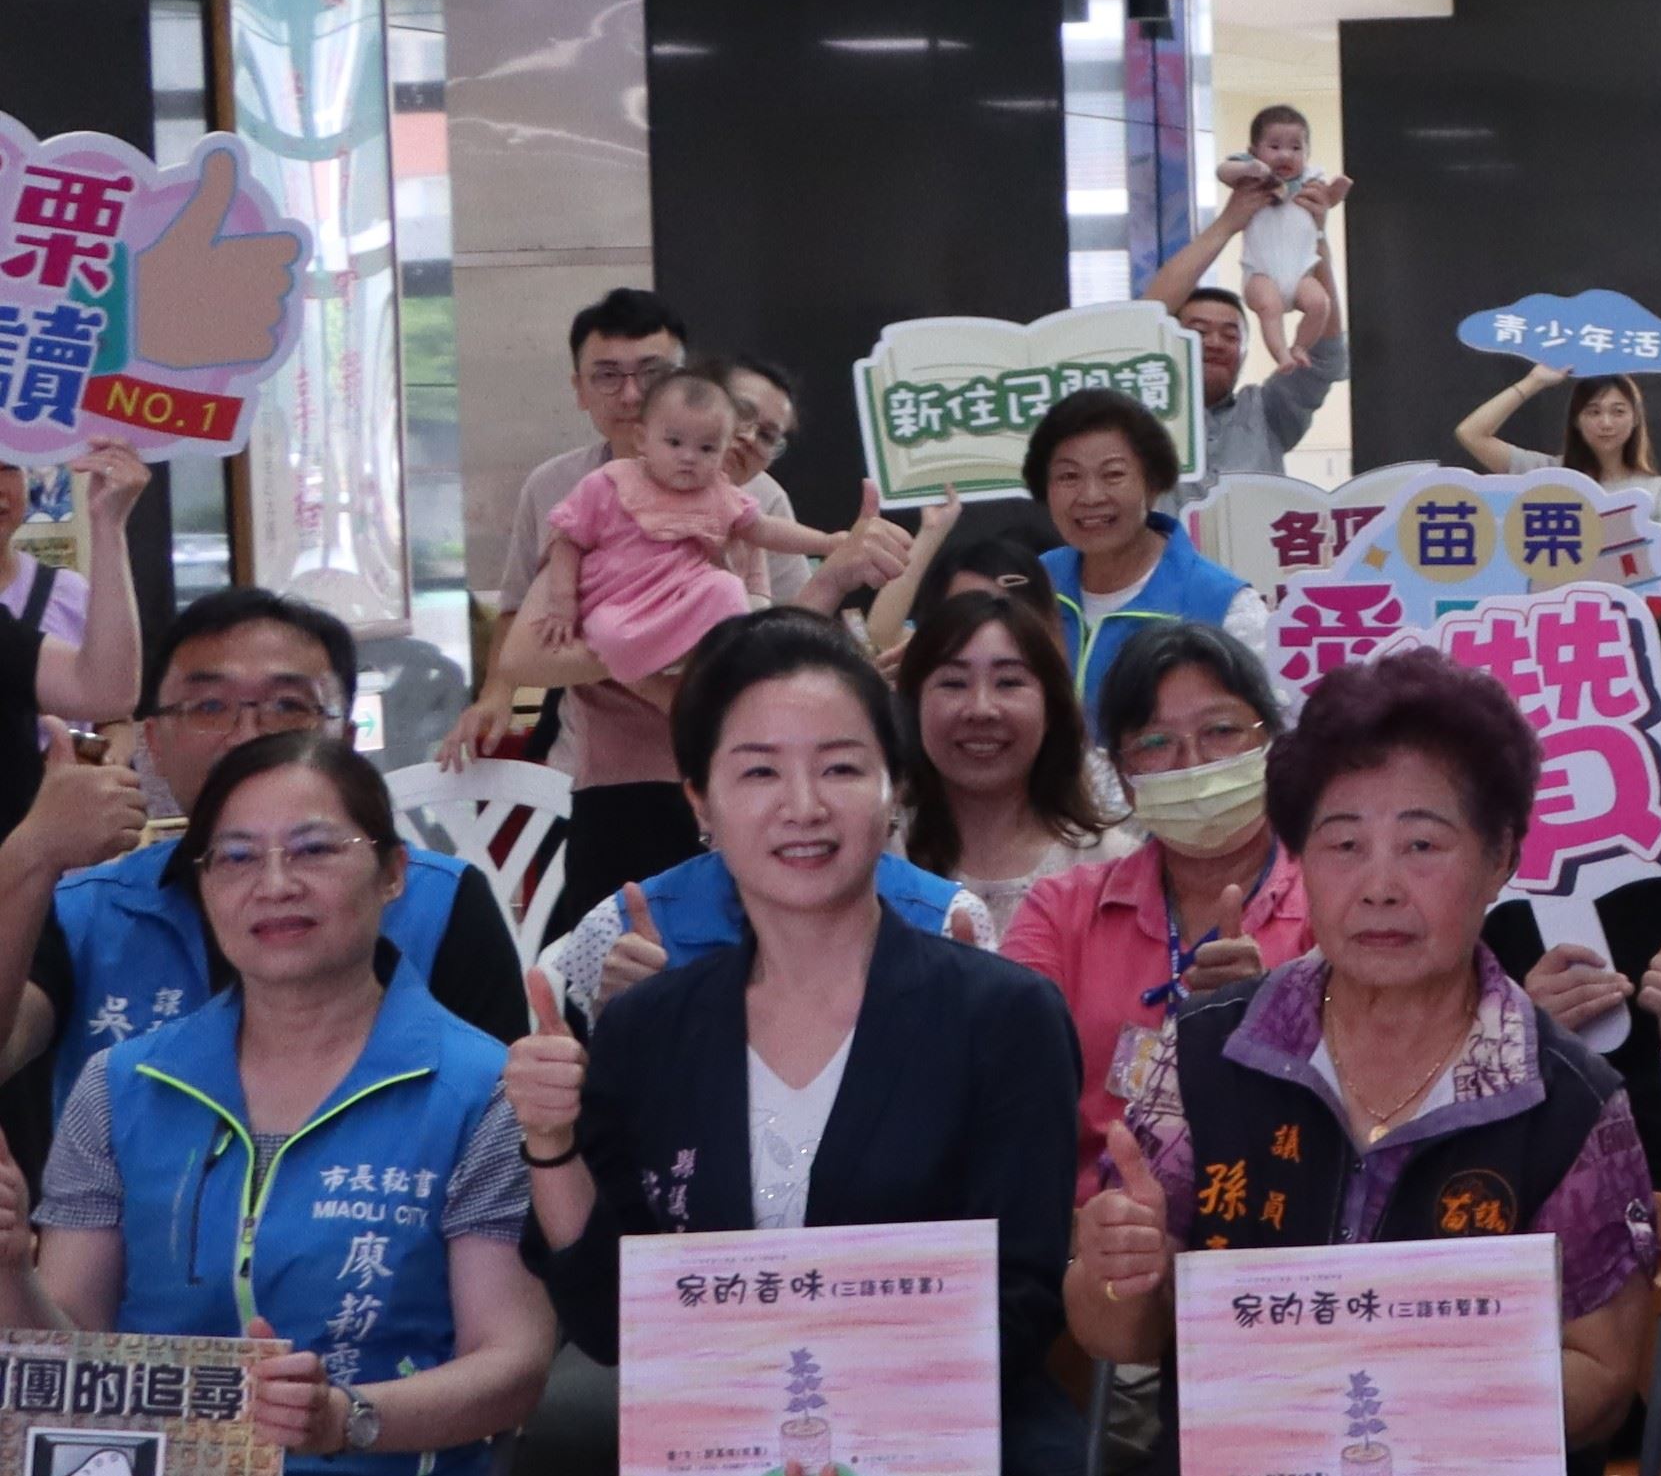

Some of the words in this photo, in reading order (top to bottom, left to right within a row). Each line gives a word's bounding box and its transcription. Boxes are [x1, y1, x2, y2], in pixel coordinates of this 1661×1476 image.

[0, 165, 133, 291] 栗
[107, 381, 217, 433] NO.1
[1417, 501, 1582, 567] 苗栗
[320, 1164, 437, 1198] 市長秘書
[313, 1200, 386, 1222] MIAOLI
[395, 1206, 431, 1228] CITY
[676, 1268, 825, 1307] 家的香味
[1232, 1288, 1382, 1328] 家的香味
[0, 1358, 246, 1421] 團的追尋
